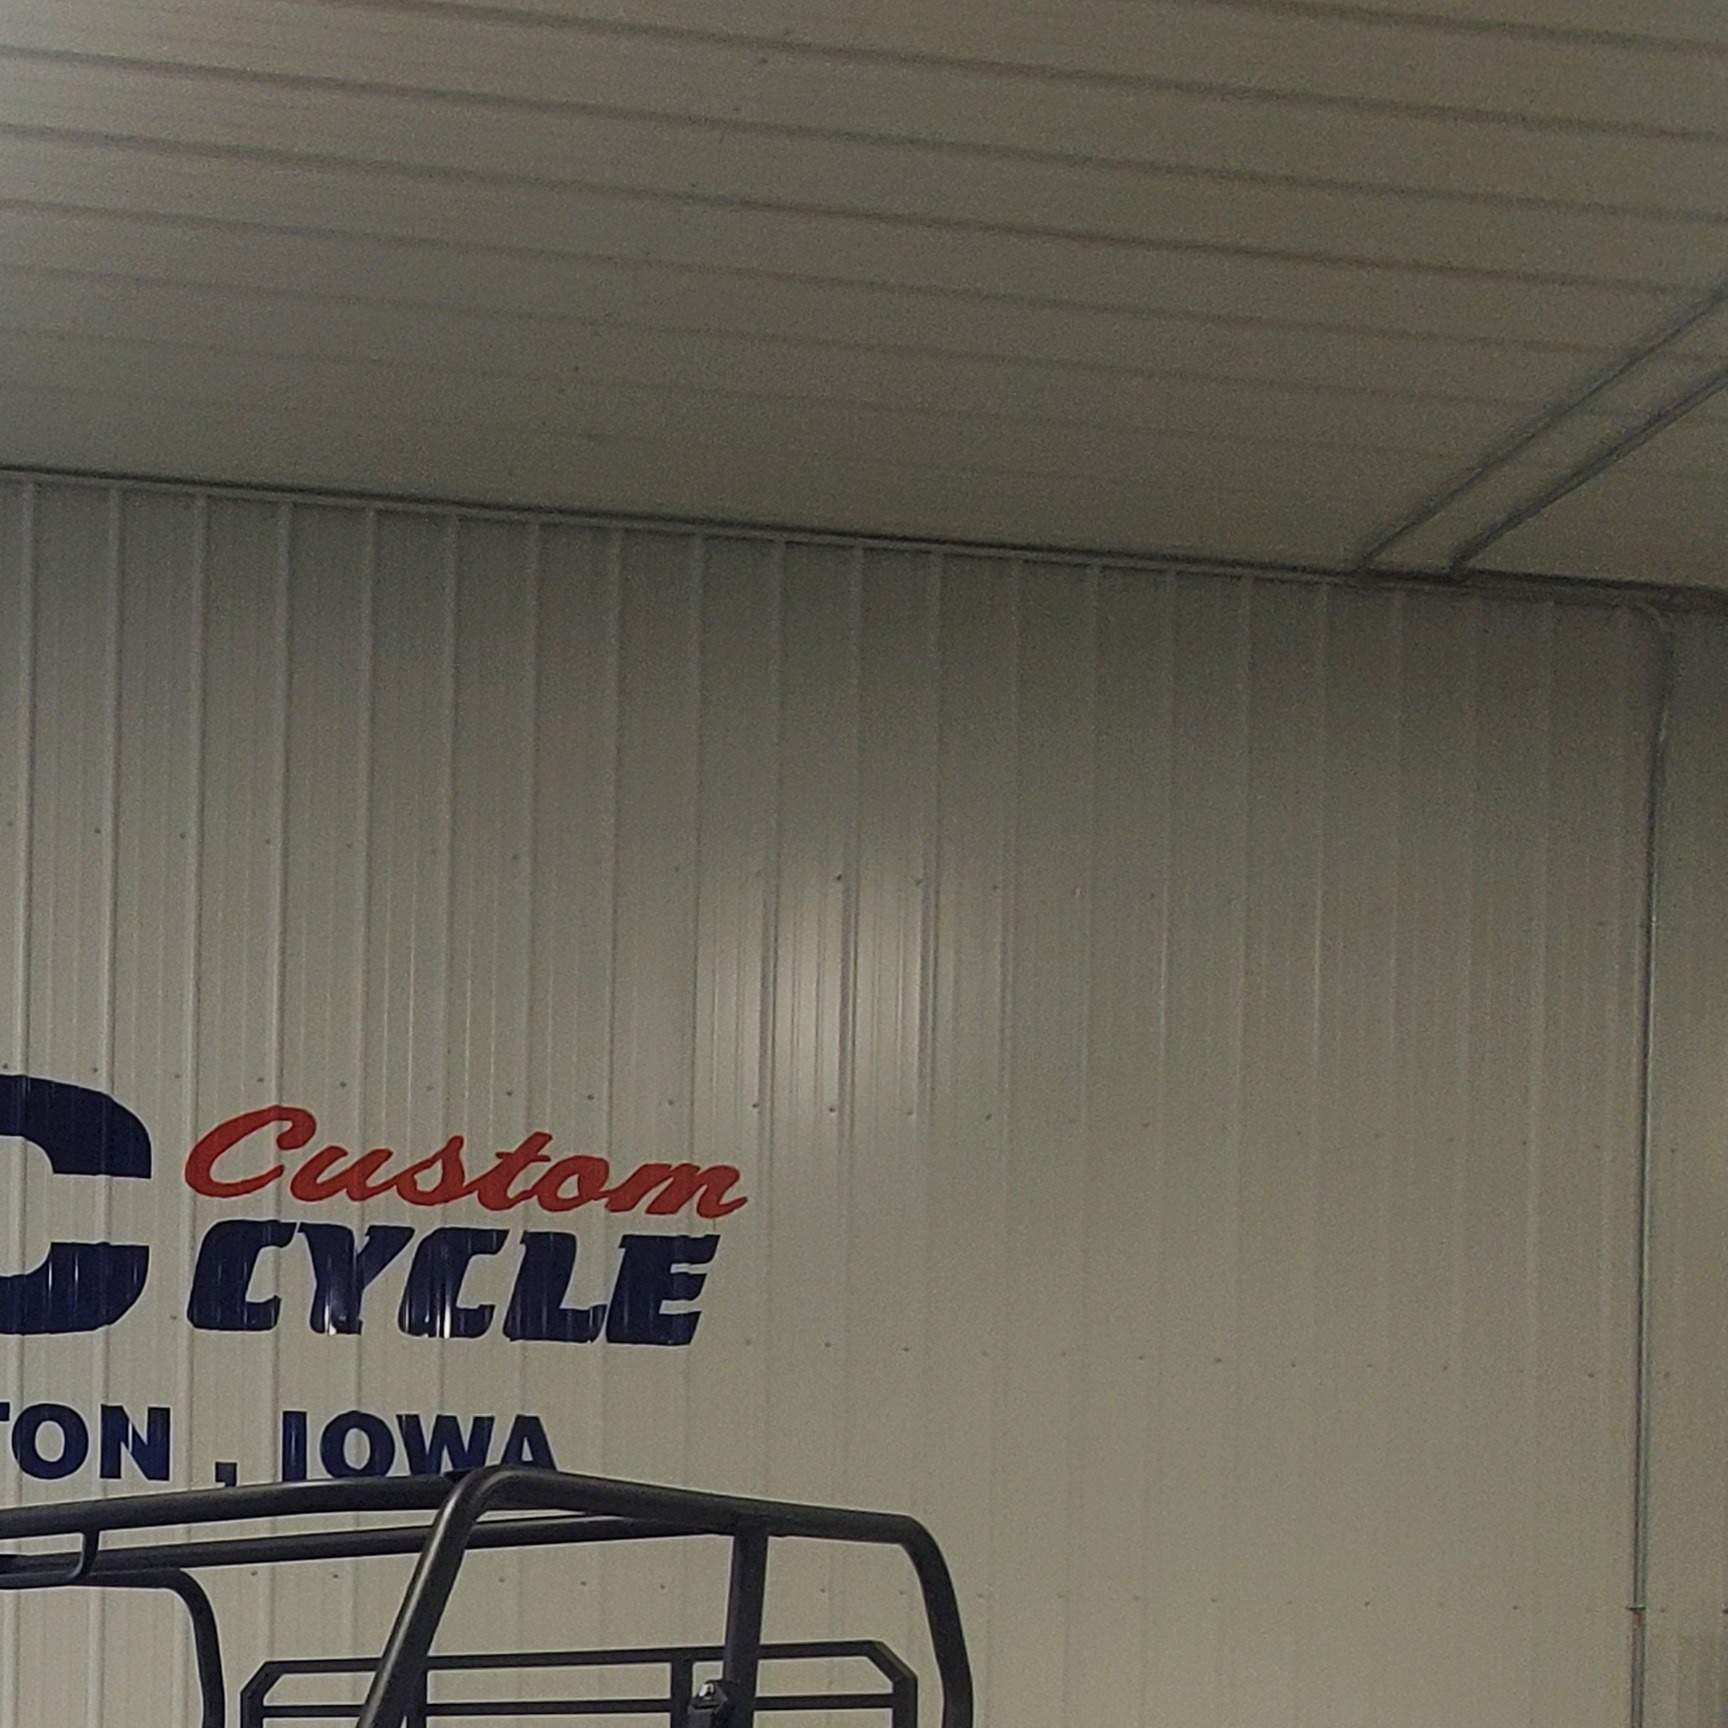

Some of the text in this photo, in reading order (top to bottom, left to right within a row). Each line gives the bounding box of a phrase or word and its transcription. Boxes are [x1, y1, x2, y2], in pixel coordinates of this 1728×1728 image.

[184, 1104, 749, 1219] Custom
[186, 1218, 721, 1346] CYCLE
[281, 1409, 557, 1483] IOWA
